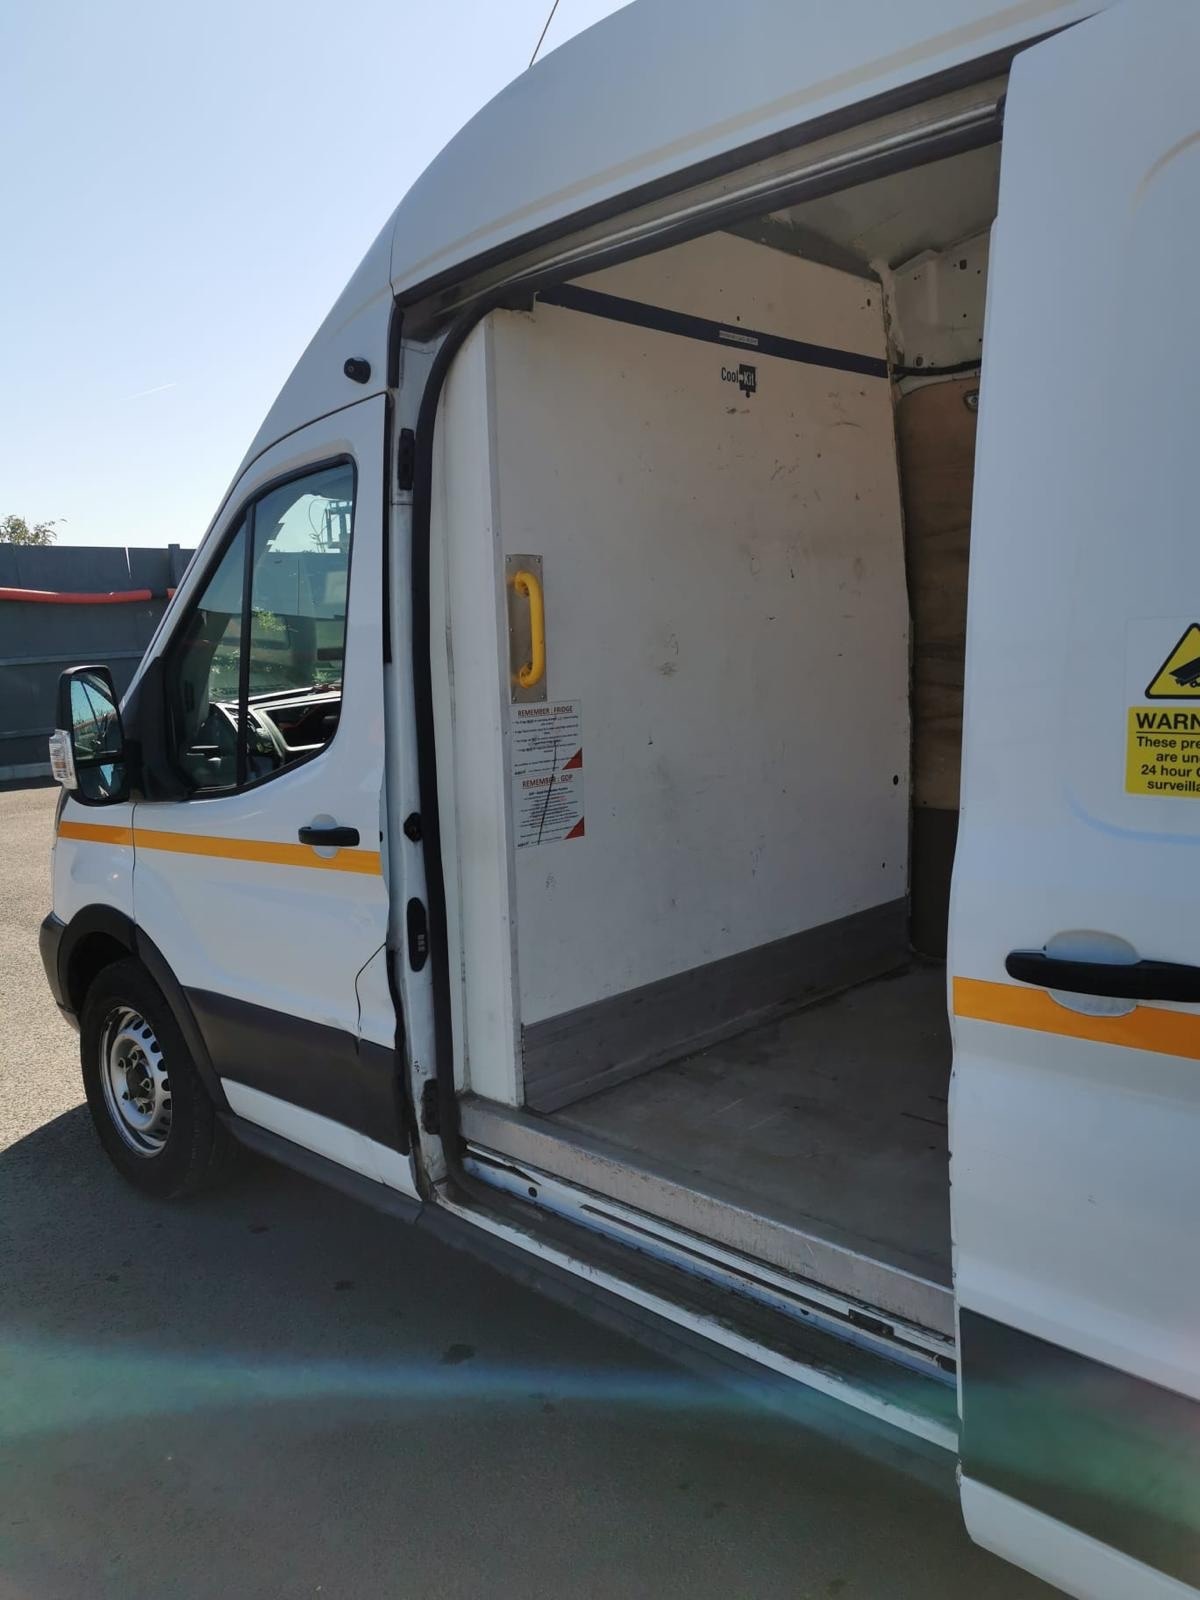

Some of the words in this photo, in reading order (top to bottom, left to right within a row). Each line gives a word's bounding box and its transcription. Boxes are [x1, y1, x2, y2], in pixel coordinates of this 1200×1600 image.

[518, 708, 550, 717] REMEMBER
[554, 705, 573, 714] FRIDGE
[1136, 713, 1200, 730] WARN
[1136, 736, 1177, 748] These
[1156, 753, 1178, 763] are
[1182, 754, 1200, 764] un
[1141, 764, 1157, 776] 24
[1160, 765, 1192, 777] hour
